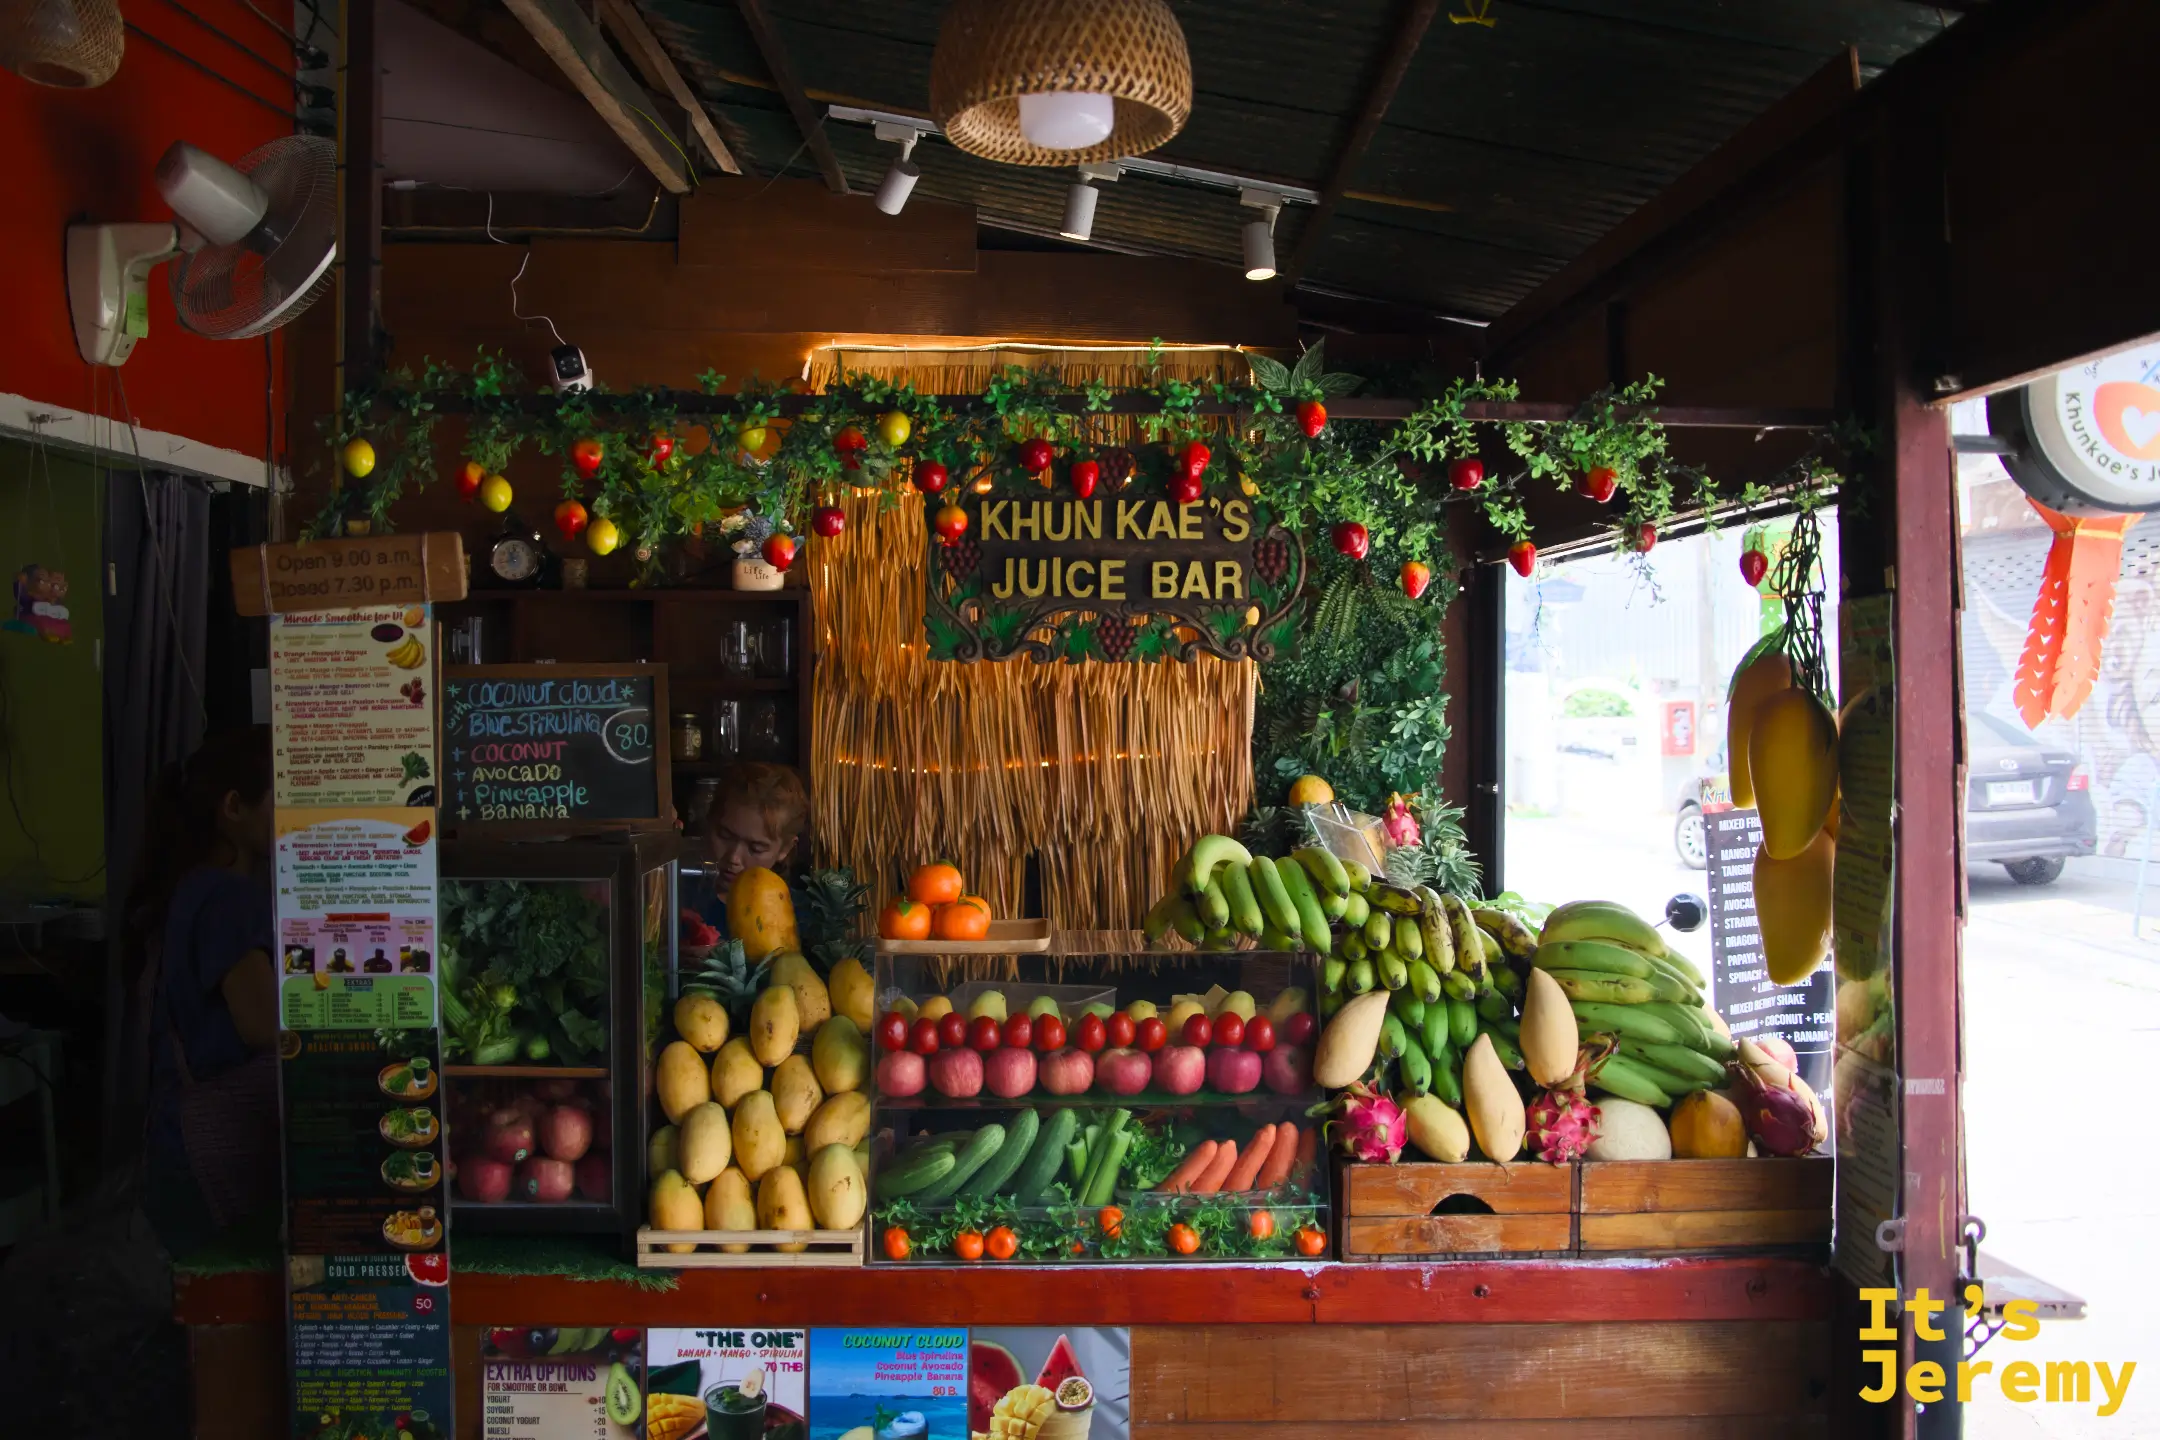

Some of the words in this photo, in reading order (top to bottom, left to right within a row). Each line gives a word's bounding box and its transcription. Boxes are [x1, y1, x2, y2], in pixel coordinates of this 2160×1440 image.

[2065, 392, 2139, 481] Khunkae's
[980, 500, 1102, 541] KHUN
[1116, 497, 1250, 543] KAE'S
[277, 555, 326, 575] Open
[332, 550, 371, 568] 9.00
[744, 566, 763, 575] Life
[992, 557, 1126, 600] JUICE
[1151, 560, 1243, 600] BAR
[270, 579, 330, 599] Closed
[334, 576, 374, 593] 7.30
[380, 575, 418, 596] p.m.
[284, 613, 322, 624] Miracle
[326, 612, 373, 623] Smoothie
[374, 612, 390, 623] for
[468, 681, 555, 707] COCONUT
[446, 699, 473, 729] with
[471, 740, 568, 763] COCONUT
[365, 767, 385, 775] Ginger
[1718, 818, 1745, 831] MIXED
[1720, 848, 1751, 861] MANGO
[1722, 882, 1752, 895] MANGO
[1726, 934, 1759, 948] DRAGON
[1728, 952, 1758, 967] PAPAYA
[1729, 968, 1763, 984] SPINACH
[1730, 1001, 1753, 1015] MIXED
[1754, 998, 1776, 1011] BERRY
[1777, 994, 1806, 1006] SHAKE
[1730, 1019, 1759, 1035] BANANA
[1765, 1014, 1804, 1027] COCONUT
[1794, 1030, 1829, 1043] BANANA
[415, 1298, 432, 1310] 50
[425, 1323, 440, 1332] Apple
[843, 1334, 912, 1349] COCONUT
[916, 1334, 964, 1349] CLOUD
[677, 1349, 712, 1358] BANANA
[720, 1349, 751, 1359] MANGO
[759, 1349, 803, 1358] SPIRULINA
[896, 1352, 917, 1360] Blue
[919, 1352, 964, 1362] Spirulina
[486, 1364, 531, 1382] EXTRA
[536, 1364, 597, 1382] OPTIONS
[764, 1362, 777, 1373] 70
[780, 1362, 804, 1372] THB
[876, 1362, 917, 1371] Coconut
[921, 1362, 964, 1371] Avocado
[874, 1372, 923, 1383] Pineapple
[927, 1372, 963, 1381] Banana
[487, 1383, 501, 1392] FOR
[502, 1383, 537, 1392] SMOOTHIE
[537, 1383, 547, 1392] OR
[548, 1383, 568, 1392] BOWL
[933, 1386, 945, 1396] 80
[947, 1386, 958, 1396] B.
[487, 1396, 511, 1404] YOGURT
[486, 1417, 515, 1425] COCONUT
[516, 1417, 541, 1425] YOGURT
[593, 1418, 606, 1426] +20
[488, 1427, 511, 1435] MUESLI
[594, 1428, 606, 1436] +10
